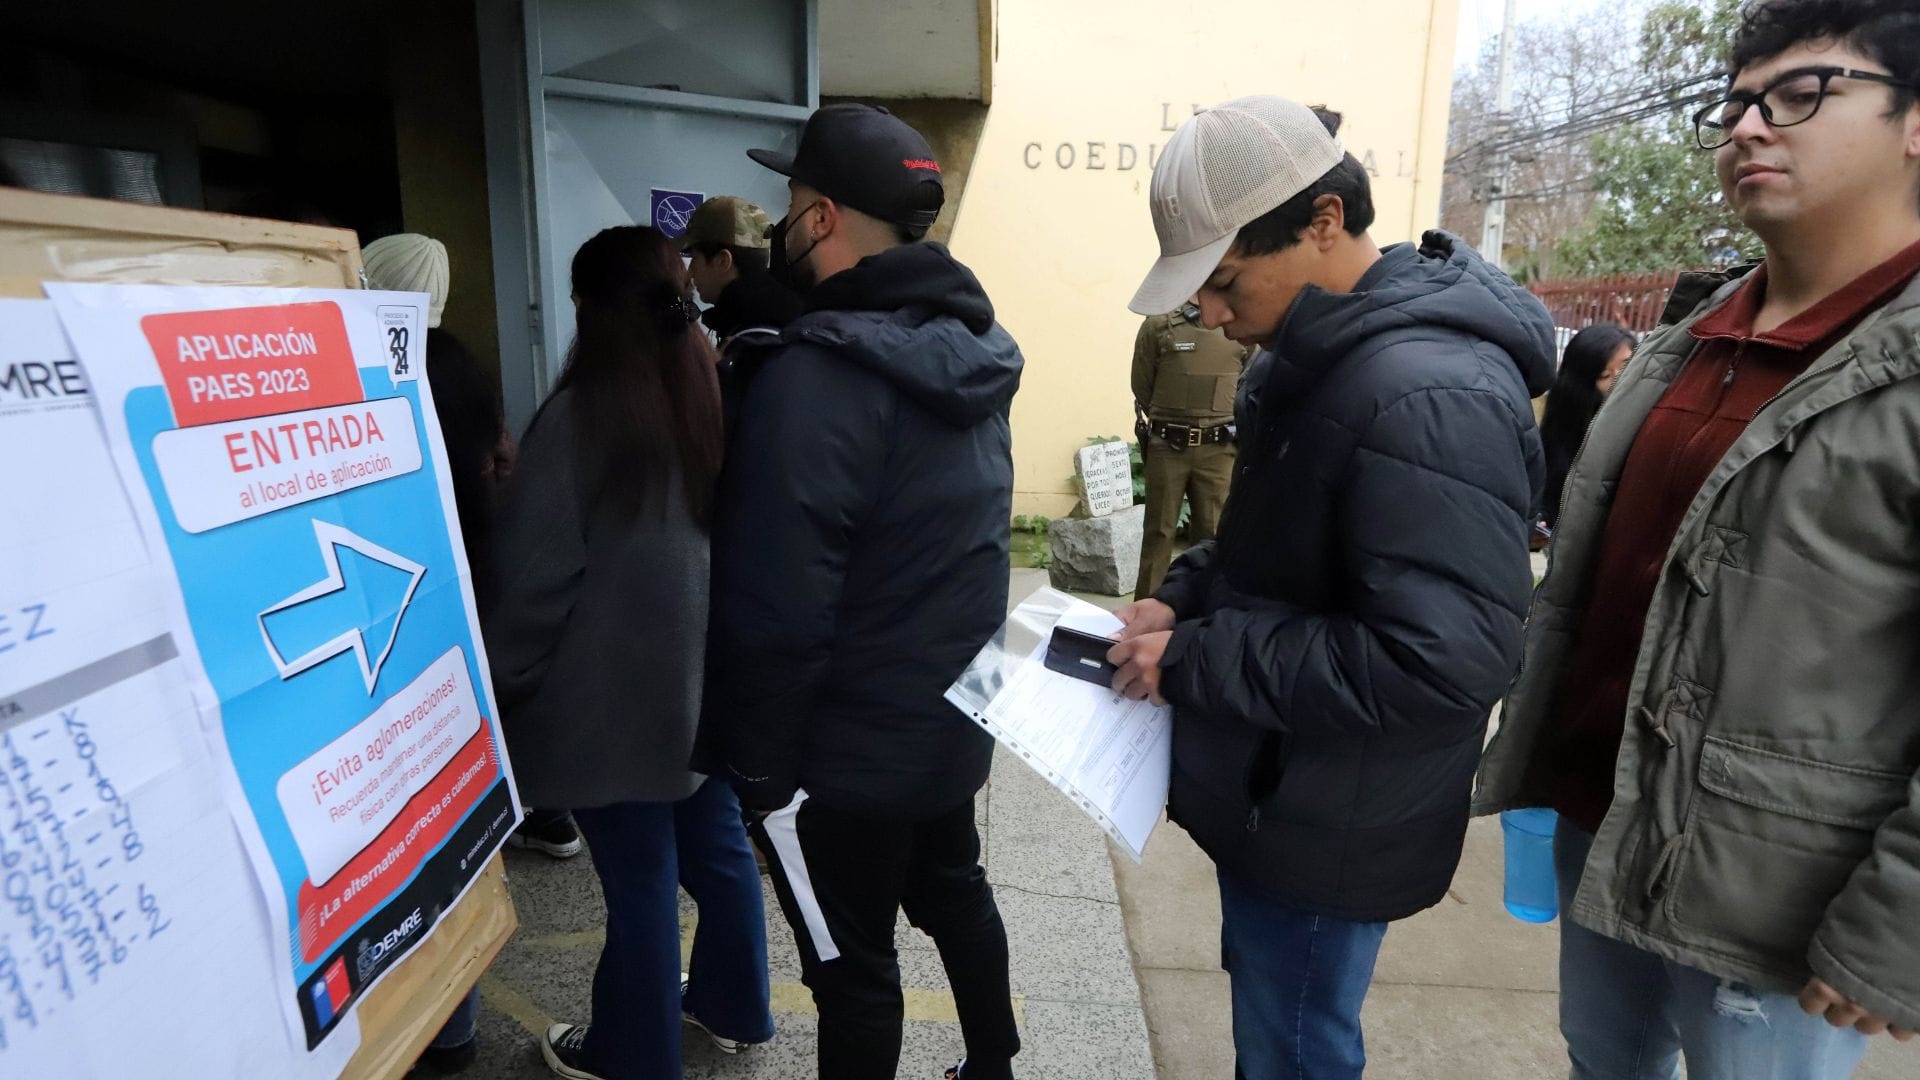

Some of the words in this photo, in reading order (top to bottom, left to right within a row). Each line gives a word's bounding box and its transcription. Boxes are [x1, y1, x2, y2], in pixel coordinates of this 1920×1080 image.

[177, 327, 318, 362] APLICACIÓN
[187, 371, 255, 404] PAES
[257, 367, 311, 396] 2023
[223, 411, 385, 473] ENTRADA
[239, 483, 258, 509] al
[259, 473, 302, 503] local
[305, 469, 328, 491] de
[331, 453, 393, 488] aplicación
[311, 753, 364, 806] ¡Evita
[365, 672, 458, 763] aglomeraciones!
[329, 776, 380, 823] Recuerda
[379, 744, 417, 783] mantener
[417, 730, 433, 750] una
[432, 704, 462, 738] distancia
[385, 782, 401, 804] con
[421, 734, 454, 772] personas
[319, 898, 342, 928] ¡La
[343, 841, 406, 902] alternativa
[404, 803, 442, 845] correcta
[441, 794, 452, 811] es
[372, 906, 422, 961] DEMRE
